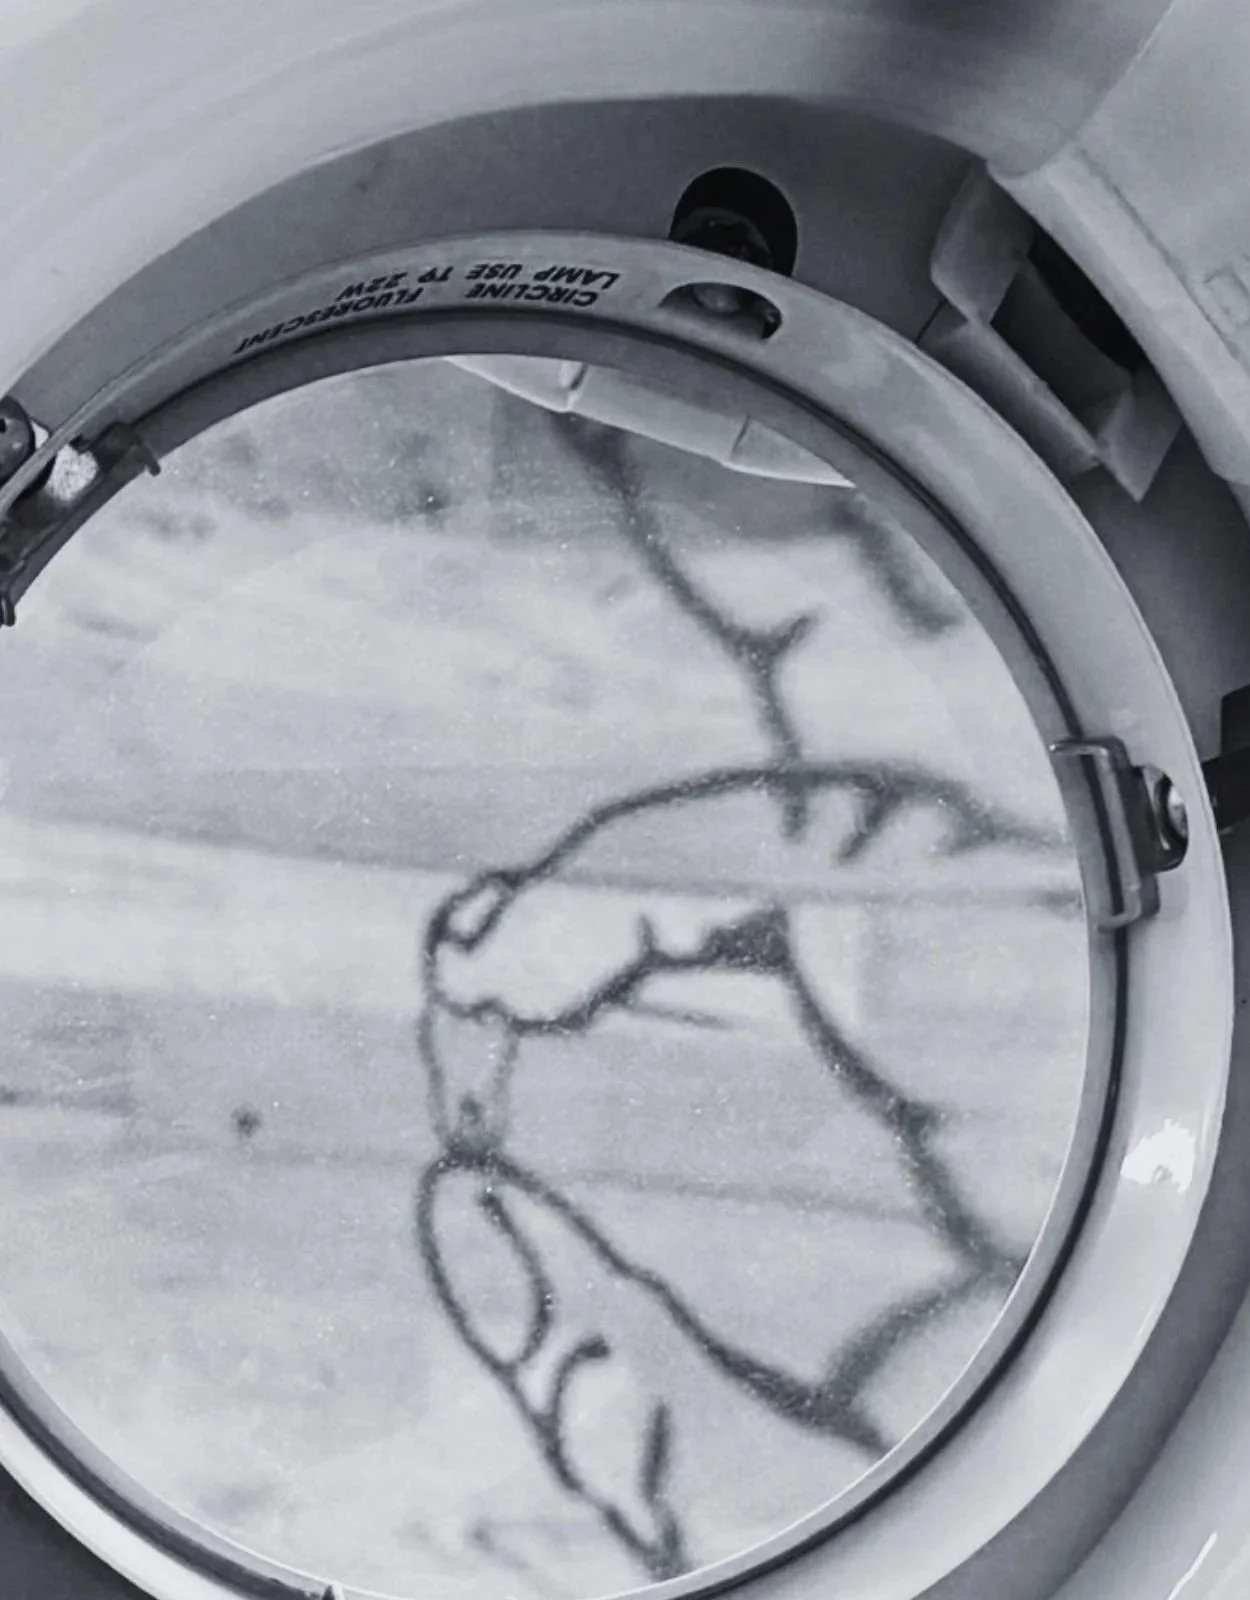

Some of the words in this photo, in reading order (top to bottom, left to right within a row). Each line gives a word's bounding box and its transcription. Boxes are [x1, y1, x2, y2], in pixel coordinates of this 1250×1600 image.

[418, 264, 454, 284] T9
[465, 263, 523, 281] USE
[532, 264, 620, 291] LAMP
[336, 270, 408, 302] 22W
[465, 281, 599, 308] CIRCLINE
[233, 287, 423, 355] FLUORESCENT
